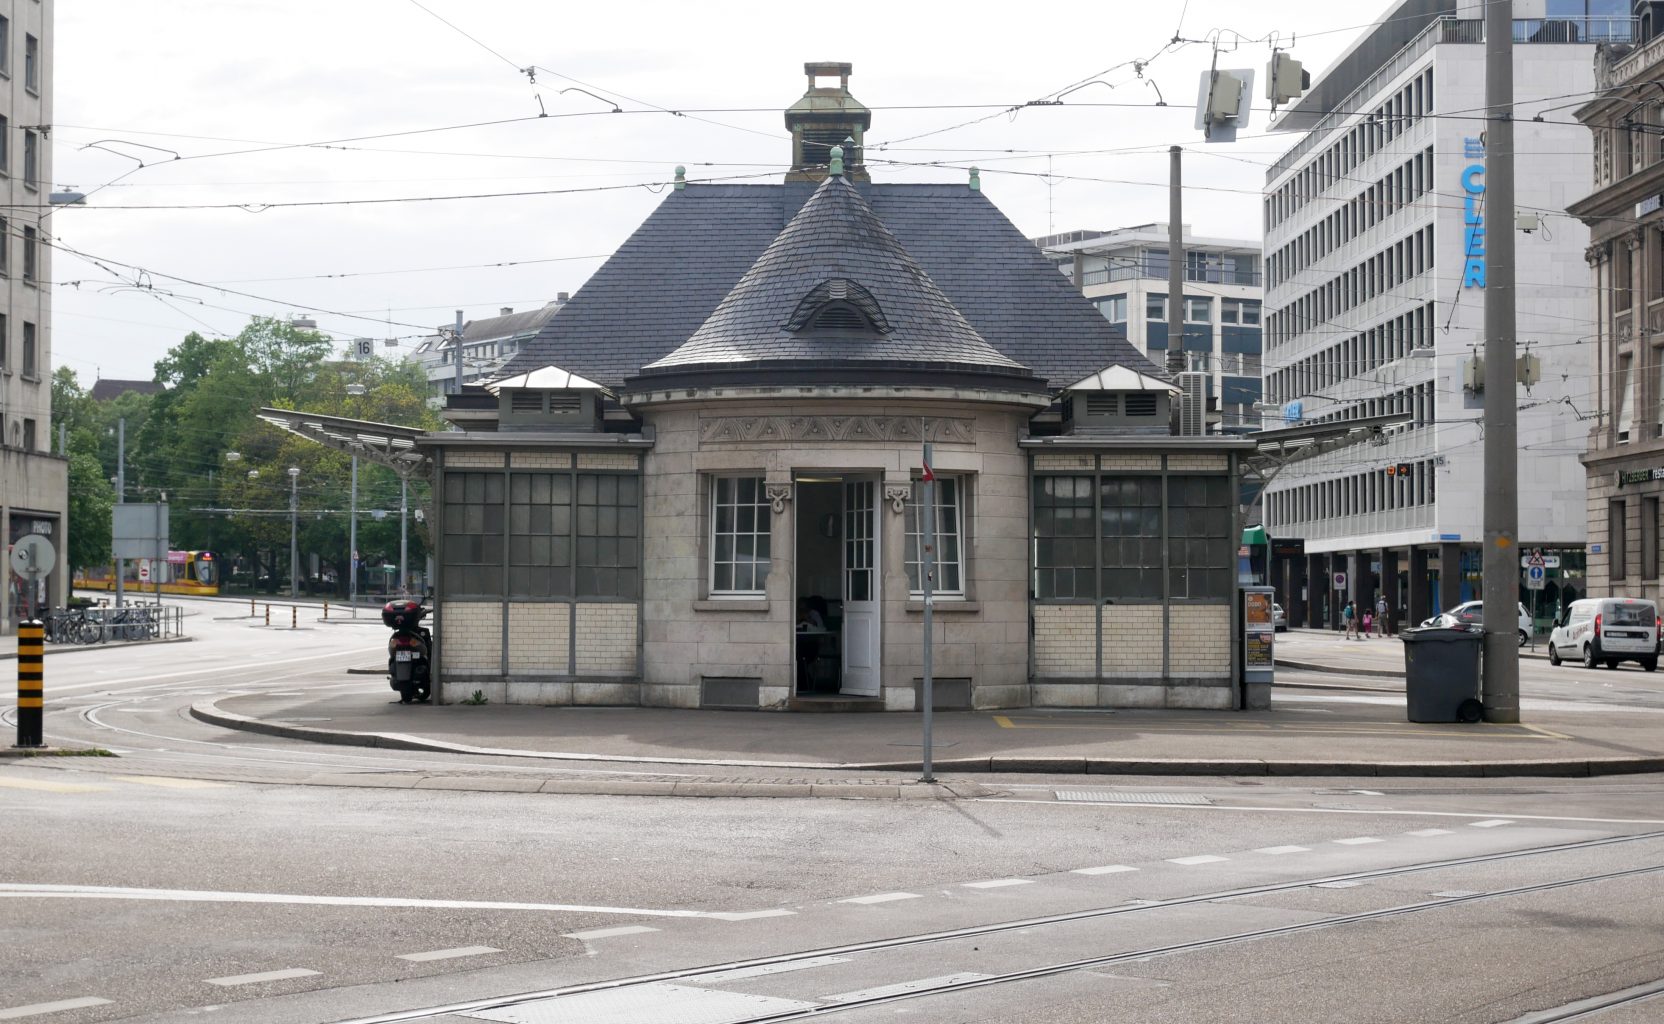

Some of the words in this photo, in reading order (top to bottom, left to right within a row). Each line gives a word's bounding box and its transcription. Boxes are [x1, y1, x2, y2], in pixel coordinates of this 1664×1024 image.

[1461, 164, 1486, 288] CLER
[358, 341, 370, 354] 16
[1436, 457, 1444, 465] 15
[33, 520, 52, 534] PHOTO
